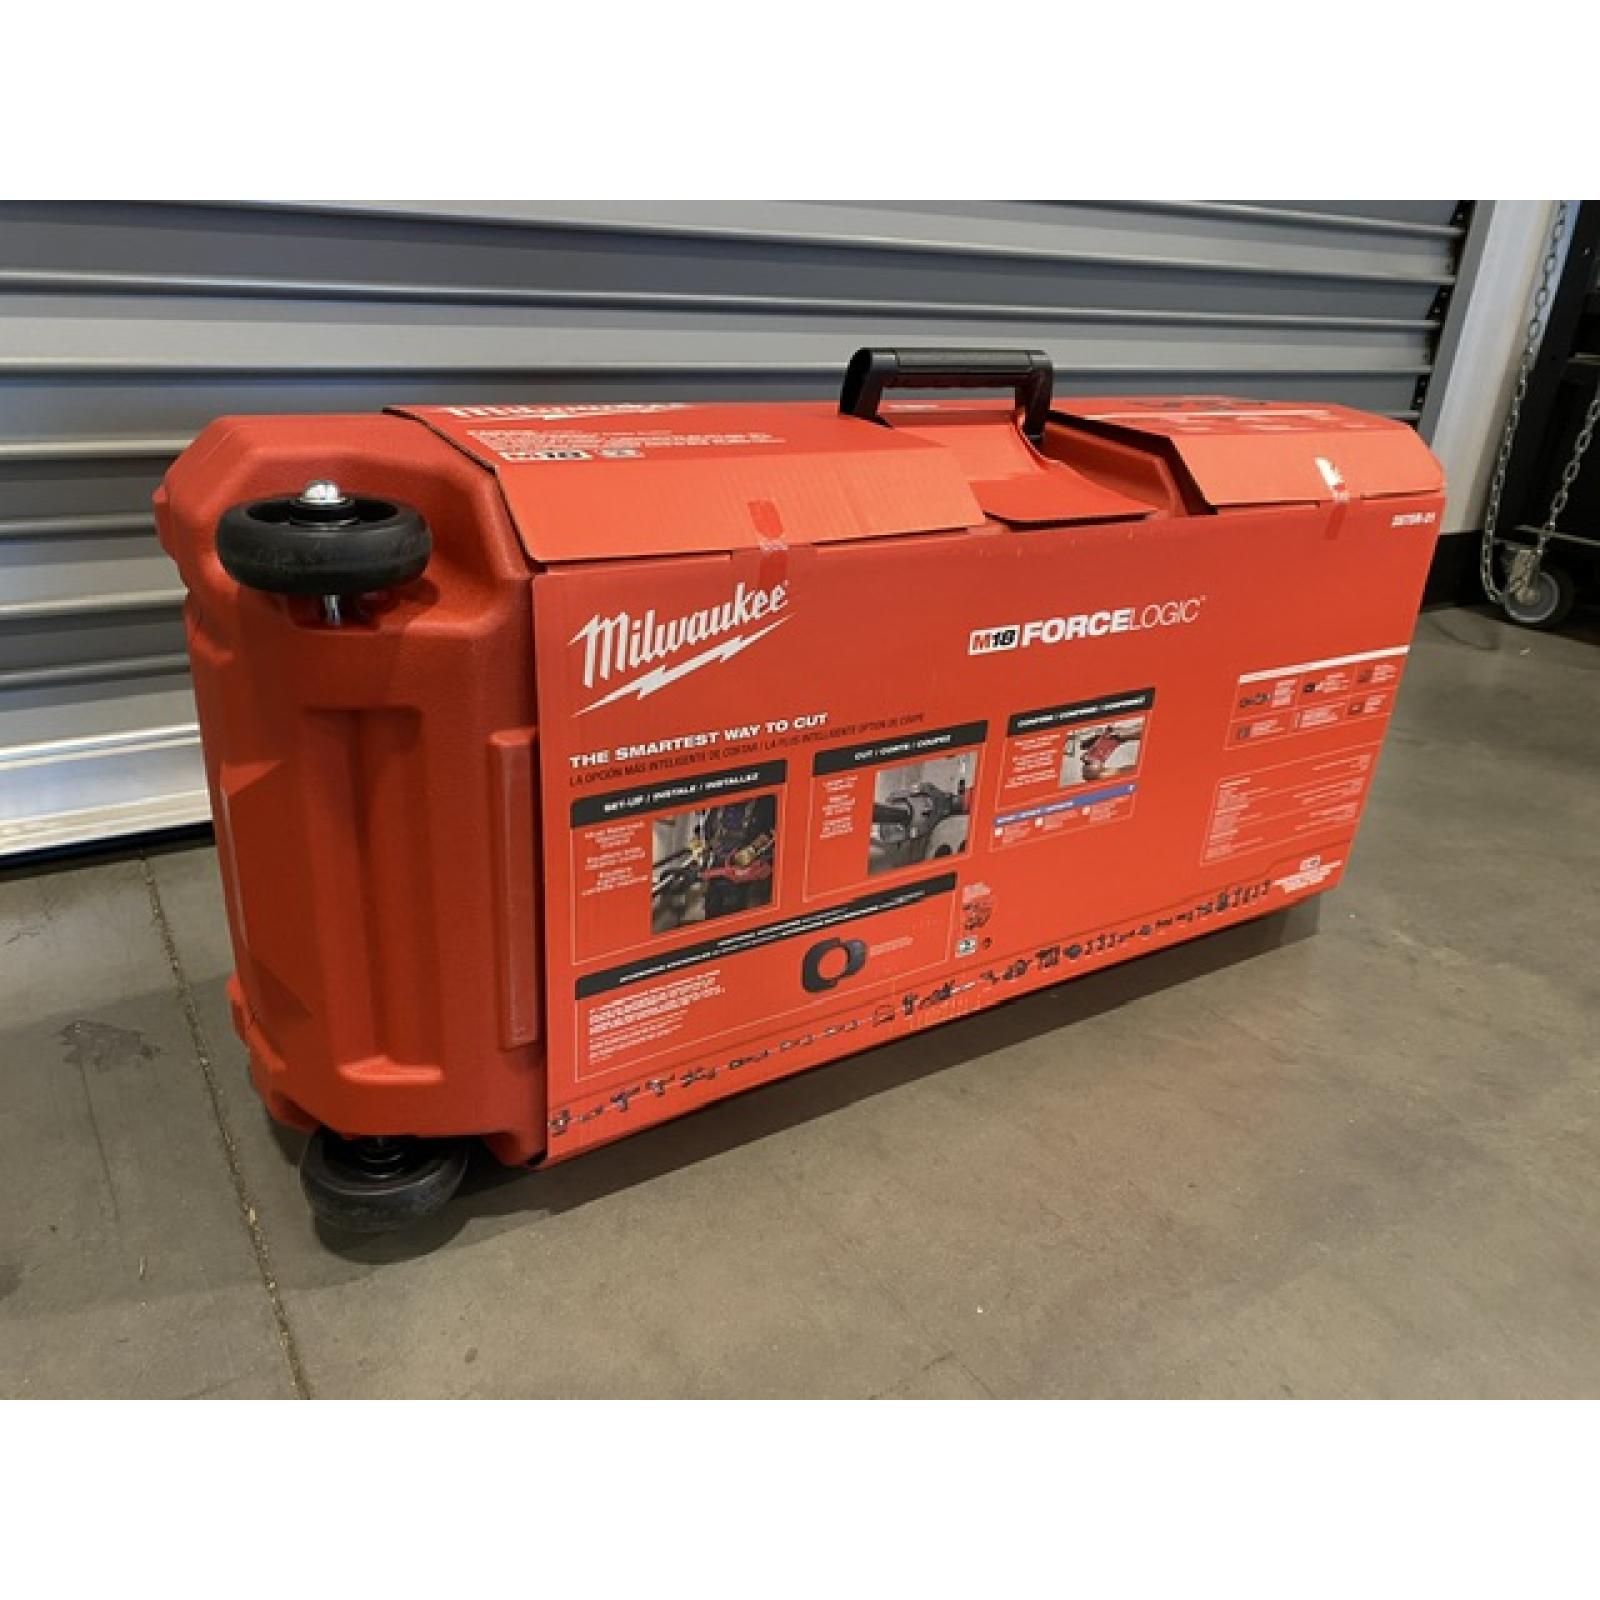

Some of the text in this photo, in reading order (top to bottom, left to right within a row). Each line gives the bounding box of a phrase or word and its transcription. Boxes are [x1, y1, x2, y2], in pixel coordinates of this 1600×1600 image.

[567, 579, 790, 688] Milwaukee
[968, 596, 1205, 655] M18 FORCELOGIC
[570, 712, 829, 768] THE SMARTEST WAY TO CUT
[569, 770, 584, 788] LA
